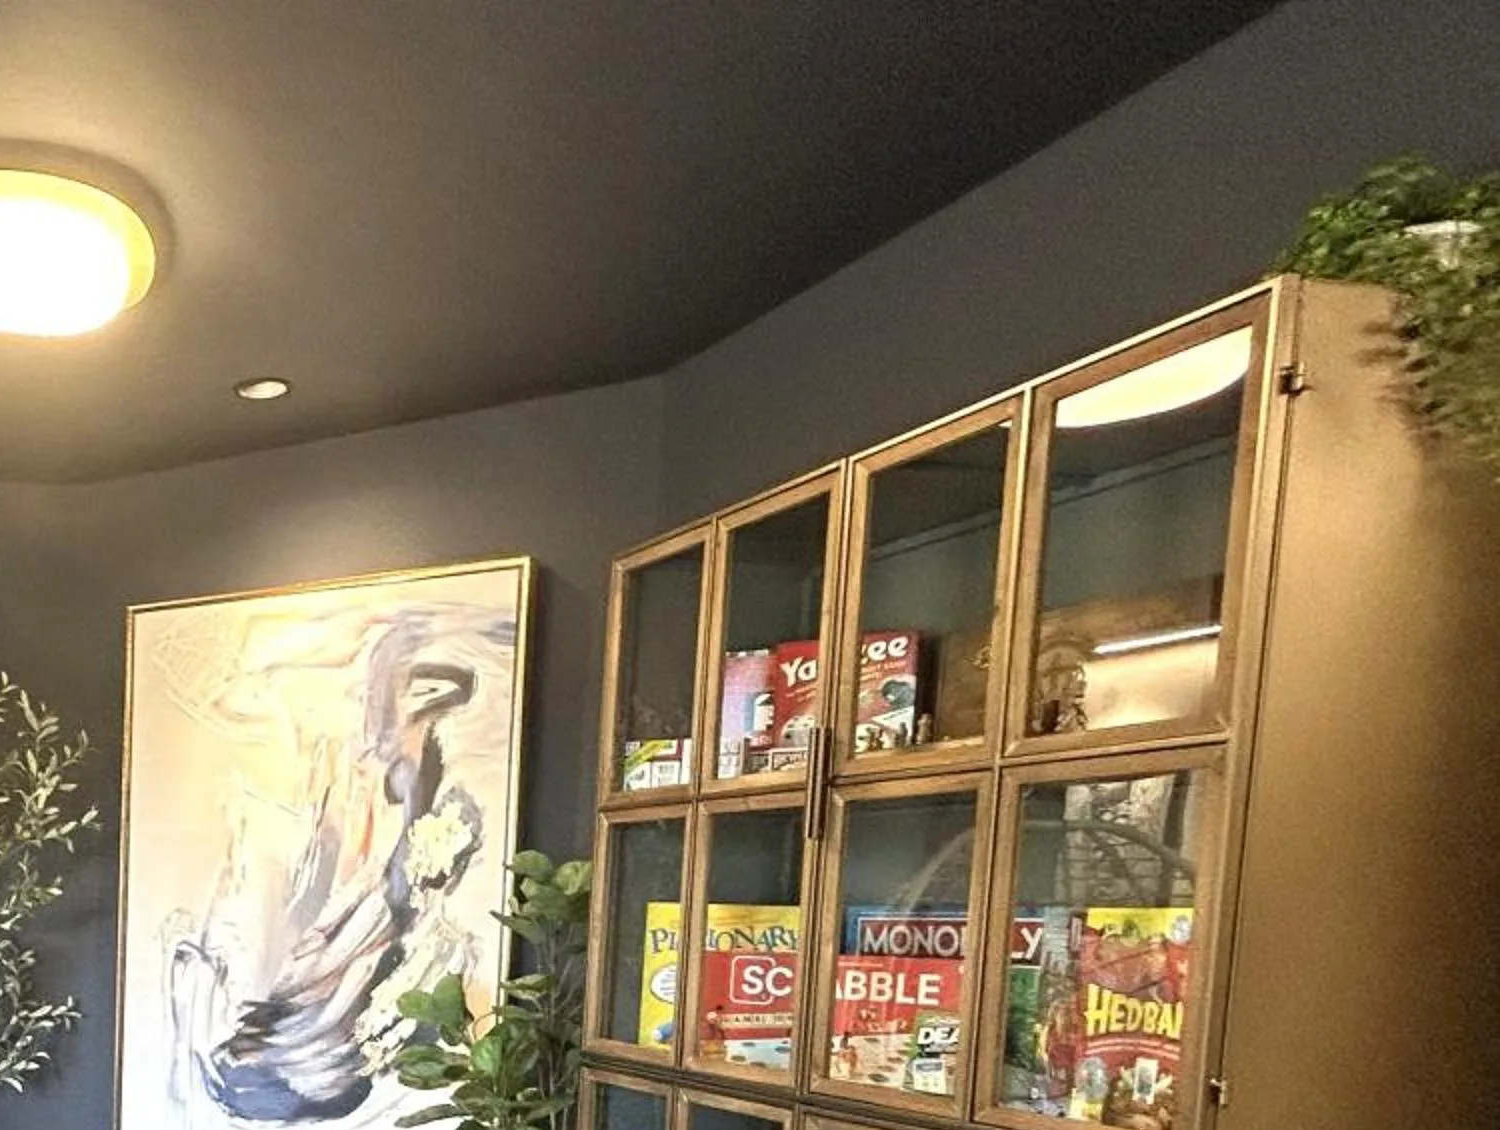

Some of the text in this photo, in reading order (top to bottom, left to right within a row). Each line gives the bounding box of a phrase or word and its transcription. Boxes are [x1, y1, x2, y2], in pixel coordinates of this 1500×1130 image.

[779, 635, 909, 688] Yaee
[651, 916, 799, 953] PIIONARY
[863, 925, 1044, 961] MONOY
[741, 965, 942, 1006] SCBBLE
[1084, 983, 1184, 1040] HEDBA
